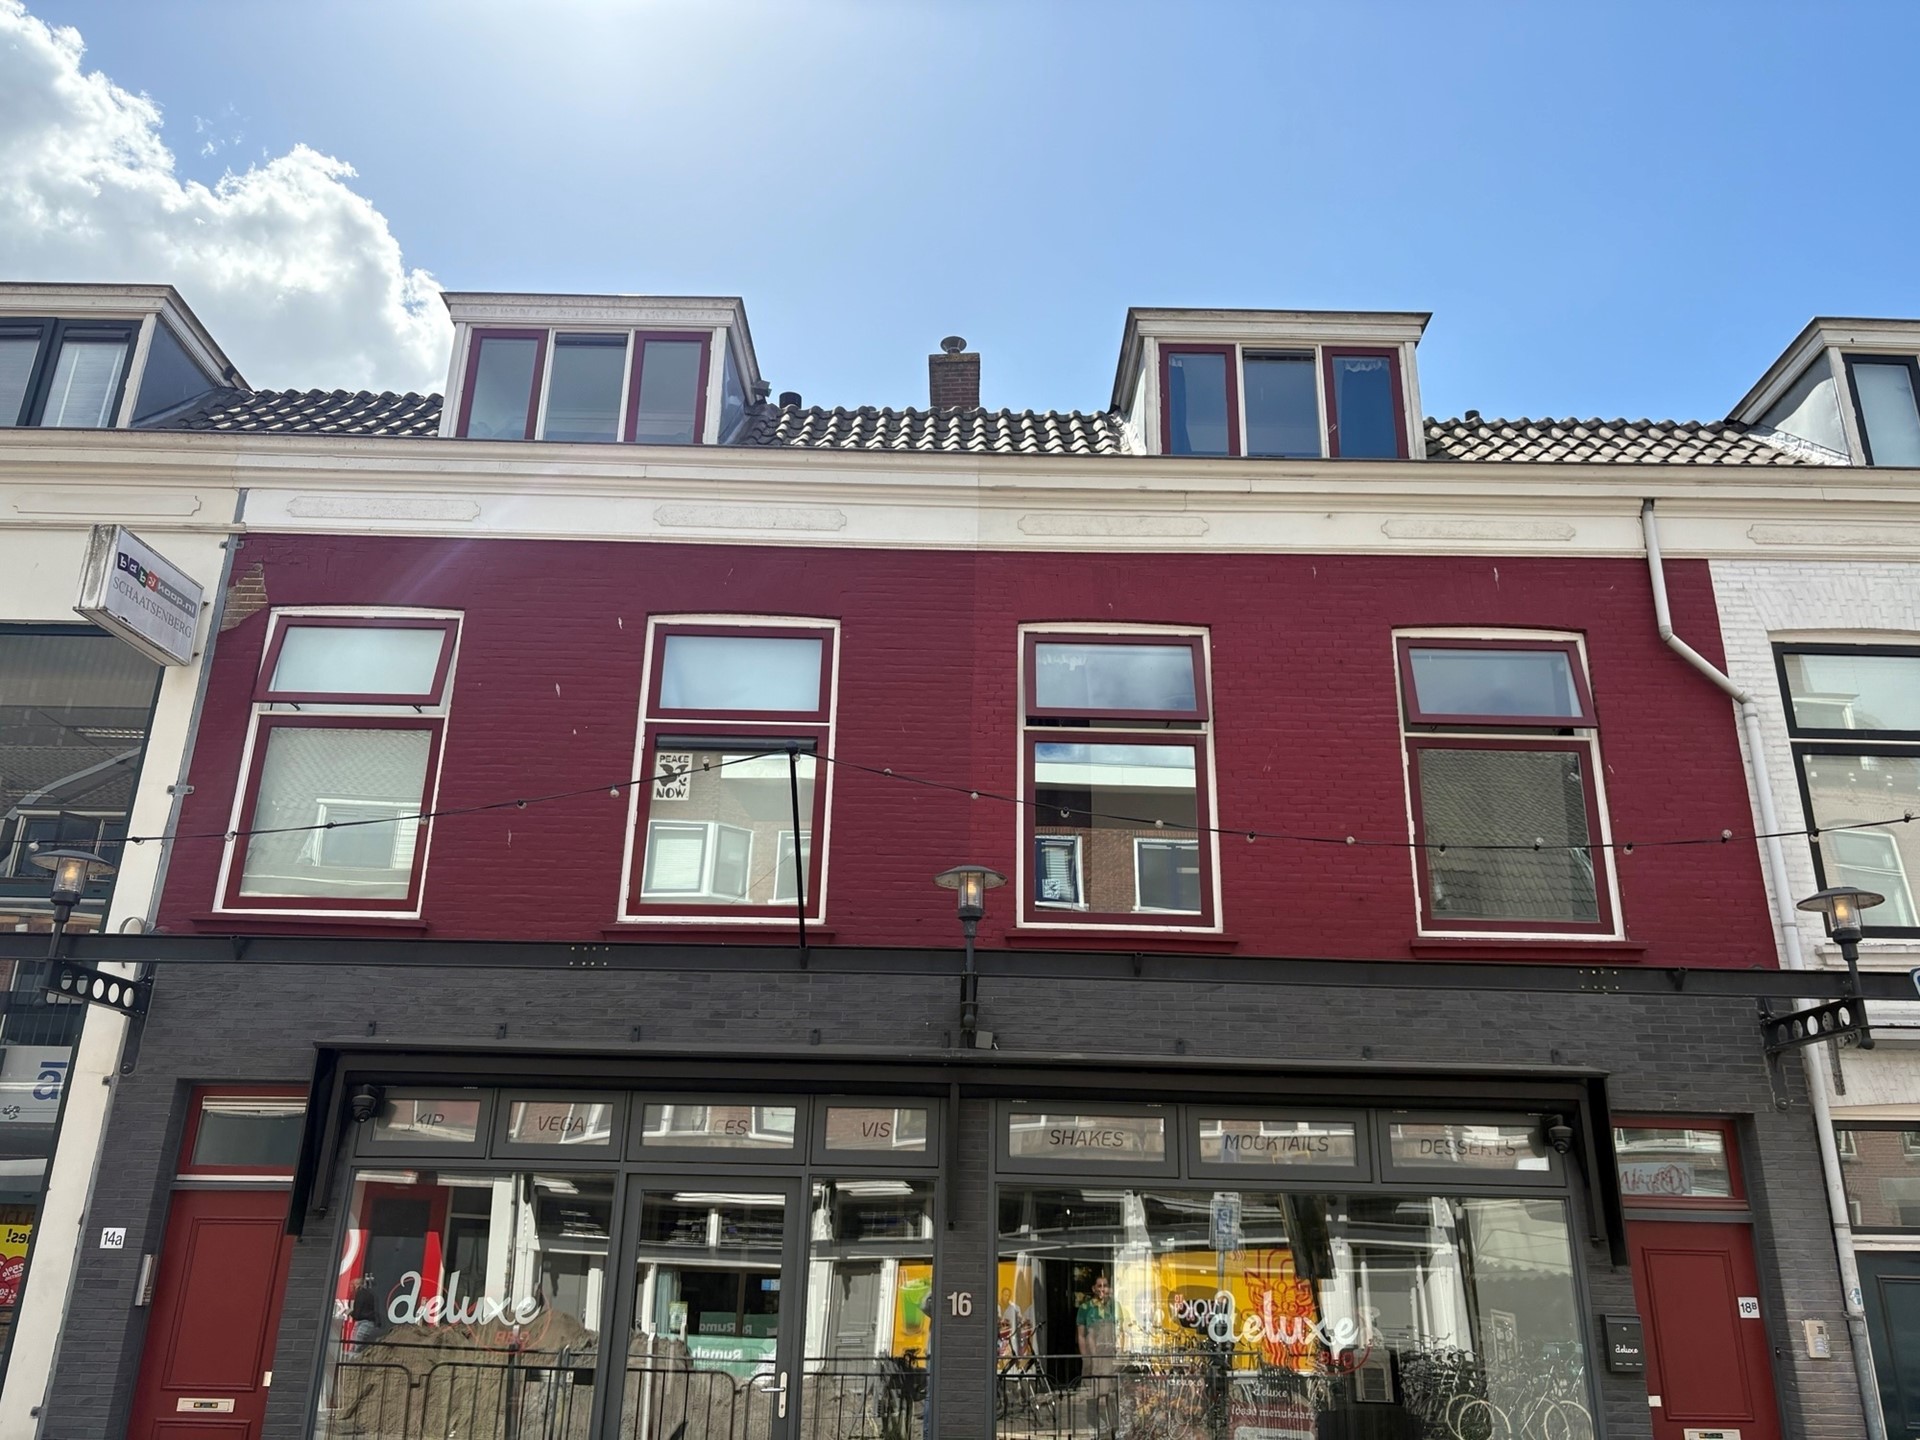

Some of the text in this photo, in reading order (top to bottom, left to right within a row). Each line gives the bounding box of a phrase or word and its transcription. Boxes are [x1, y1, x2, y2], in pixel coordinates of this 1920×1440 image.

[113, 576, 193, 639] SCHAATSENBERG
[659, 754, 689, 763] PEACE
[656, 787, 686, 798] NOW
[415, 1113, 445, 1127] KIP
[538, 1115, 585, 1133] VEGA
[861, 1121, 891, 1138] VIS
[1049, 1129, 1124, 1147] SHAKES
[1224, 1134, 1329, 1152] MOCKTAILS
[1420, 1138, 1516, 1157] DESSERTS
[103, 1231, 123, 1246] 14a
[387, 1270, 541, 1326] deluxe
[948, 1292, 972, 1316] 16
[1207, 1289, 1358, 1346] deluxe
